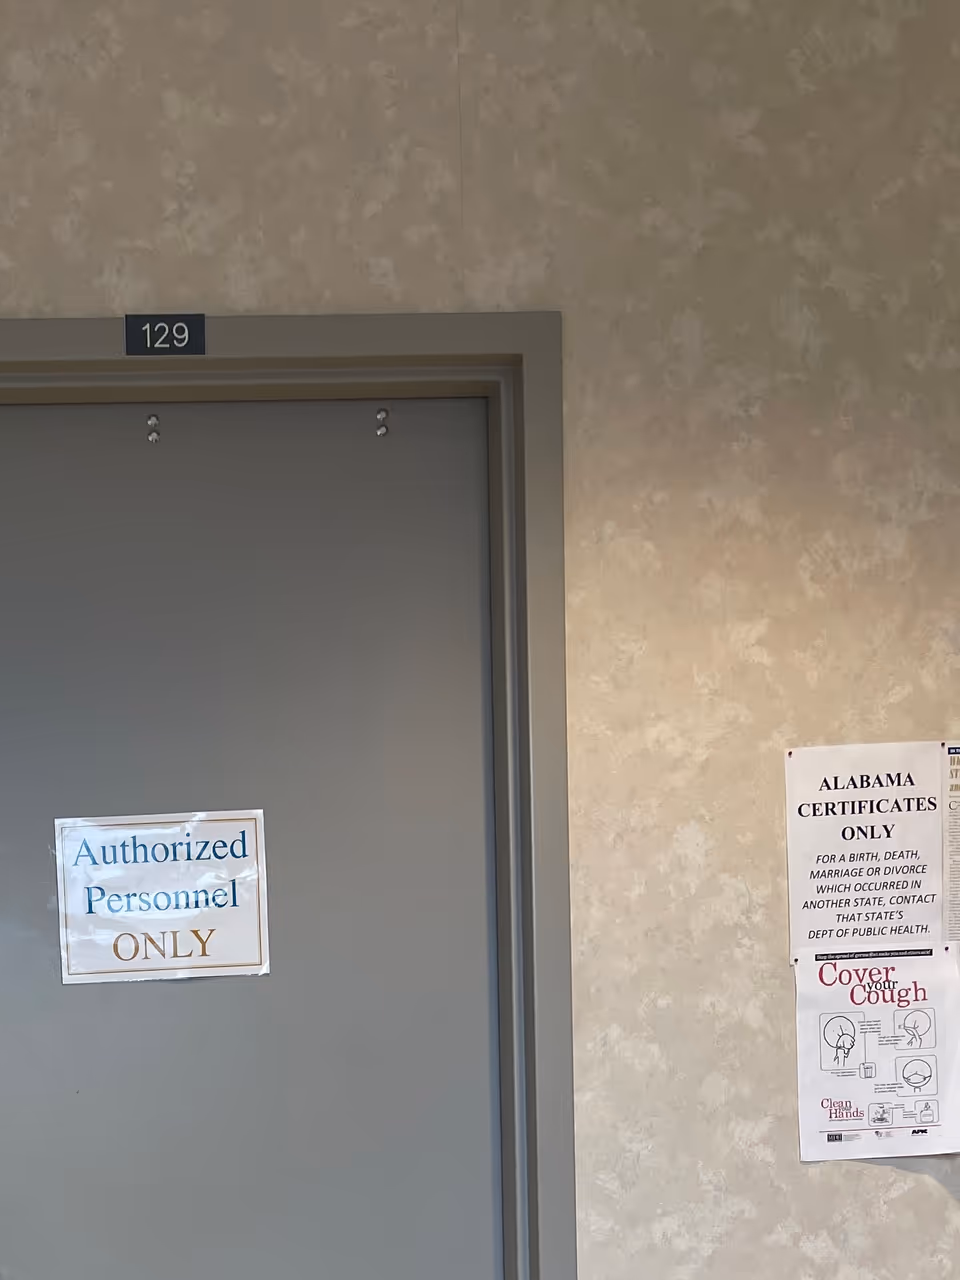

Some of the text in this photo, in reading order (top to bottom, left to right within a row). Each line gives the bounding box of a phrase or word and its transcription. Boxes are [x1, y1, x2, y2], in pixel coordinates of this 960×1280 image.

[142, 322, 189, 348] 129
[818, 772, 915, 792] ALABAMA
[798, 796, 937, 817] CERTIFICATES
[842, 824, 895, 841] ONLY
[72, 830, 249, 866] Authorized
[816, 850, 920, 864] FOR A BIRTH, DEATH,
[810, 864, 928, 880] MARRIAGE OR DIVORCE
[816, 880, 922, 894] WHICH OCCURRED IN
[84, 879, 240, 915] Personnel
[802, 894, 937, 910] ANOTHER STATE, CONTACT
[836, 910, 904, 923] THAT STATE'S
[808, 924, 930, 940] DEPT OF PUBLIC HEALTH.
[112, 928, 216, 961] ONLY
[818, 962, 896, 986] Cover
[850, 981, 928, 1008] Cough
[866, 980, 898, 993] your
[821, 1098, 852, 1108] Clean
[828, 1108, 864, 1119] Hands
